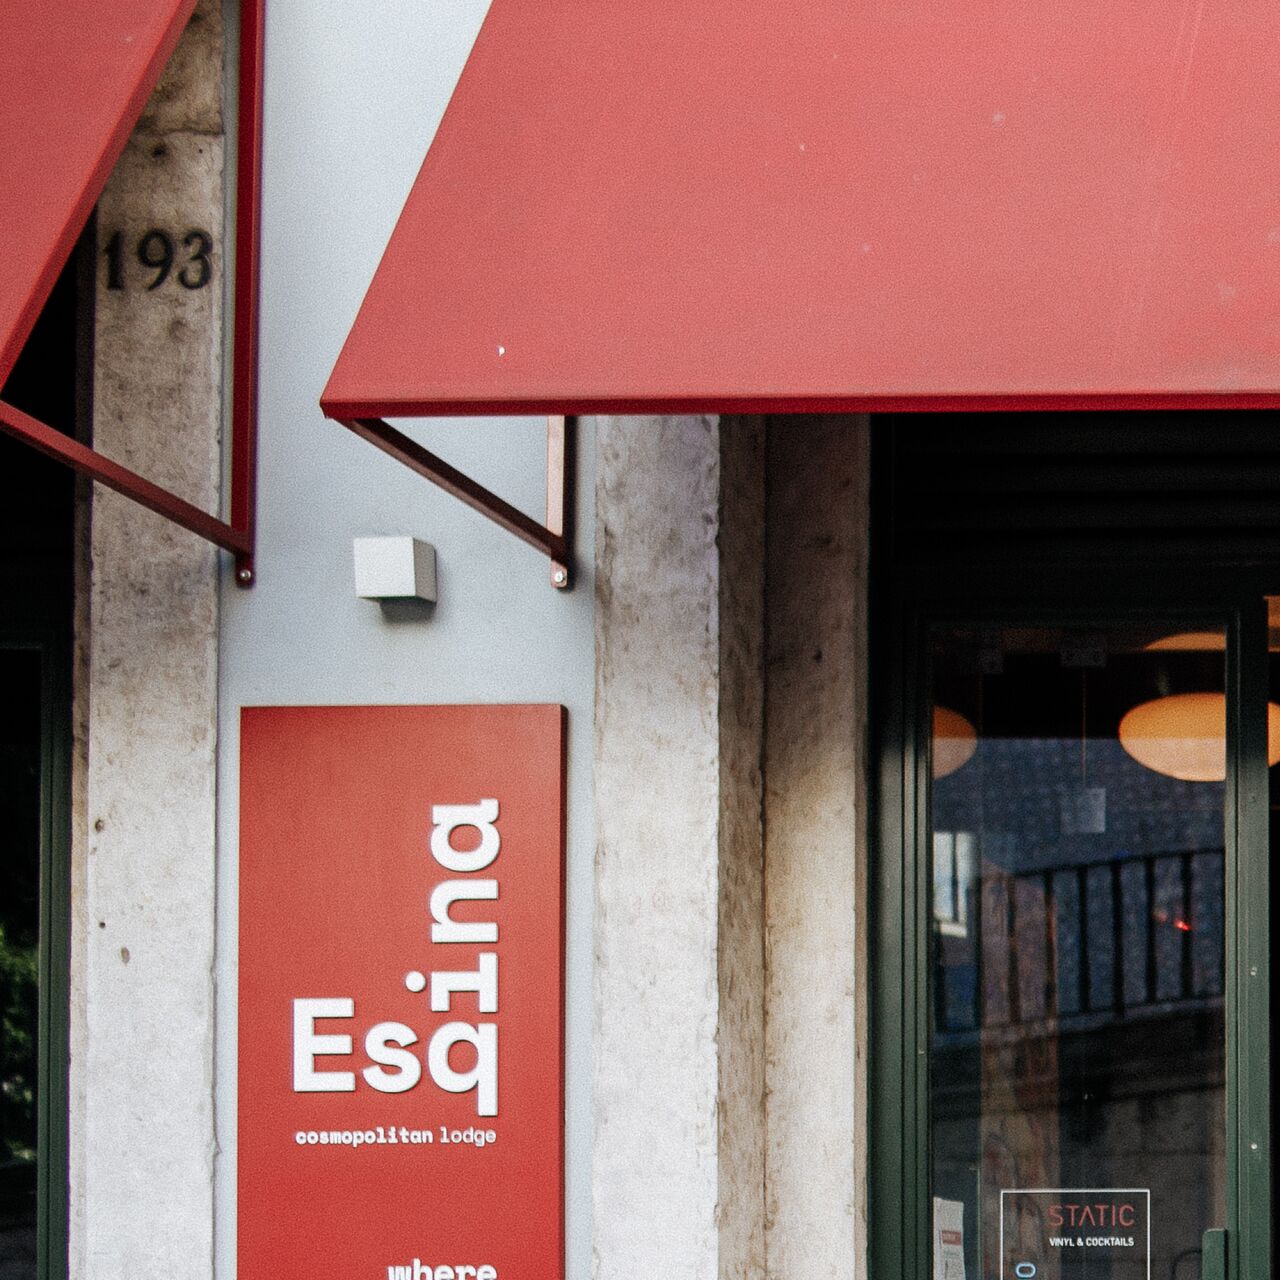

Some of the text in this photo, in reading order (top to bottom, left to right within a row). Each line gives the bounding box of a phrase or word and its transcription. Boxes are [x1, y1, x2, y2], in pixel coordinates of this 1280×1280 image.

[103, 229, 213, 291] 193
[295, 1125, 497, 1148] cosmopolitan lodge
[1047, 1204, 1135, 1227] STATIC
[1048, 1236, 1135, 1247] VINYL & COCKTAILS
